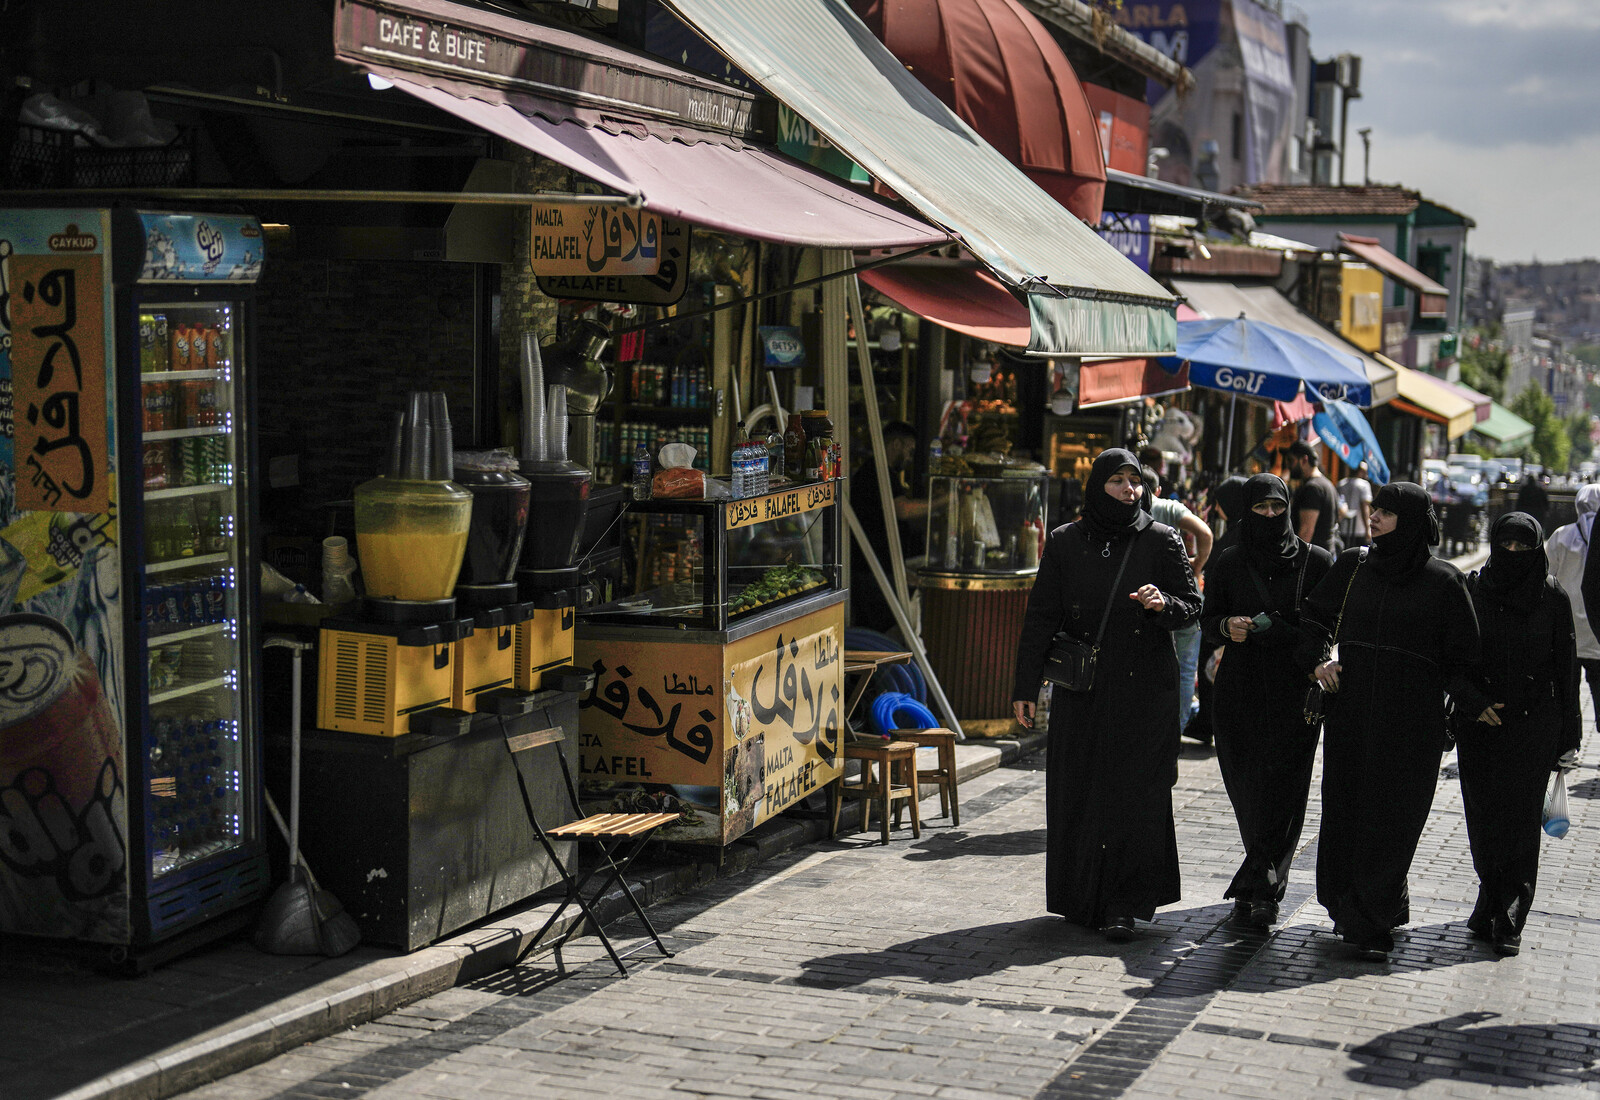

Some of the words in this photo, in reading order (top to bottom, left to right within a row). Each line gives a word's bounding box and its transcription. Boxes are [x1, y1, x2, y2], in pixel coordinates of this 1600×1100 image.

[380, 18, 423, 50] CAFE
[428, 30, 441, 54] &
[688, 91, 719, 125] malta
[535, 208, 564, 227] MALTA
[51, 239, 95, 251] ÇAYKUR
[535, 236, 582, 260] FALAFEL
[1215, 367, 1267, 395] Golf
[766, 493, 801, 519] FALAFEL
[766, 745, 794, 777] MALTA
[766, 760, 817, 816] FALAFEL
